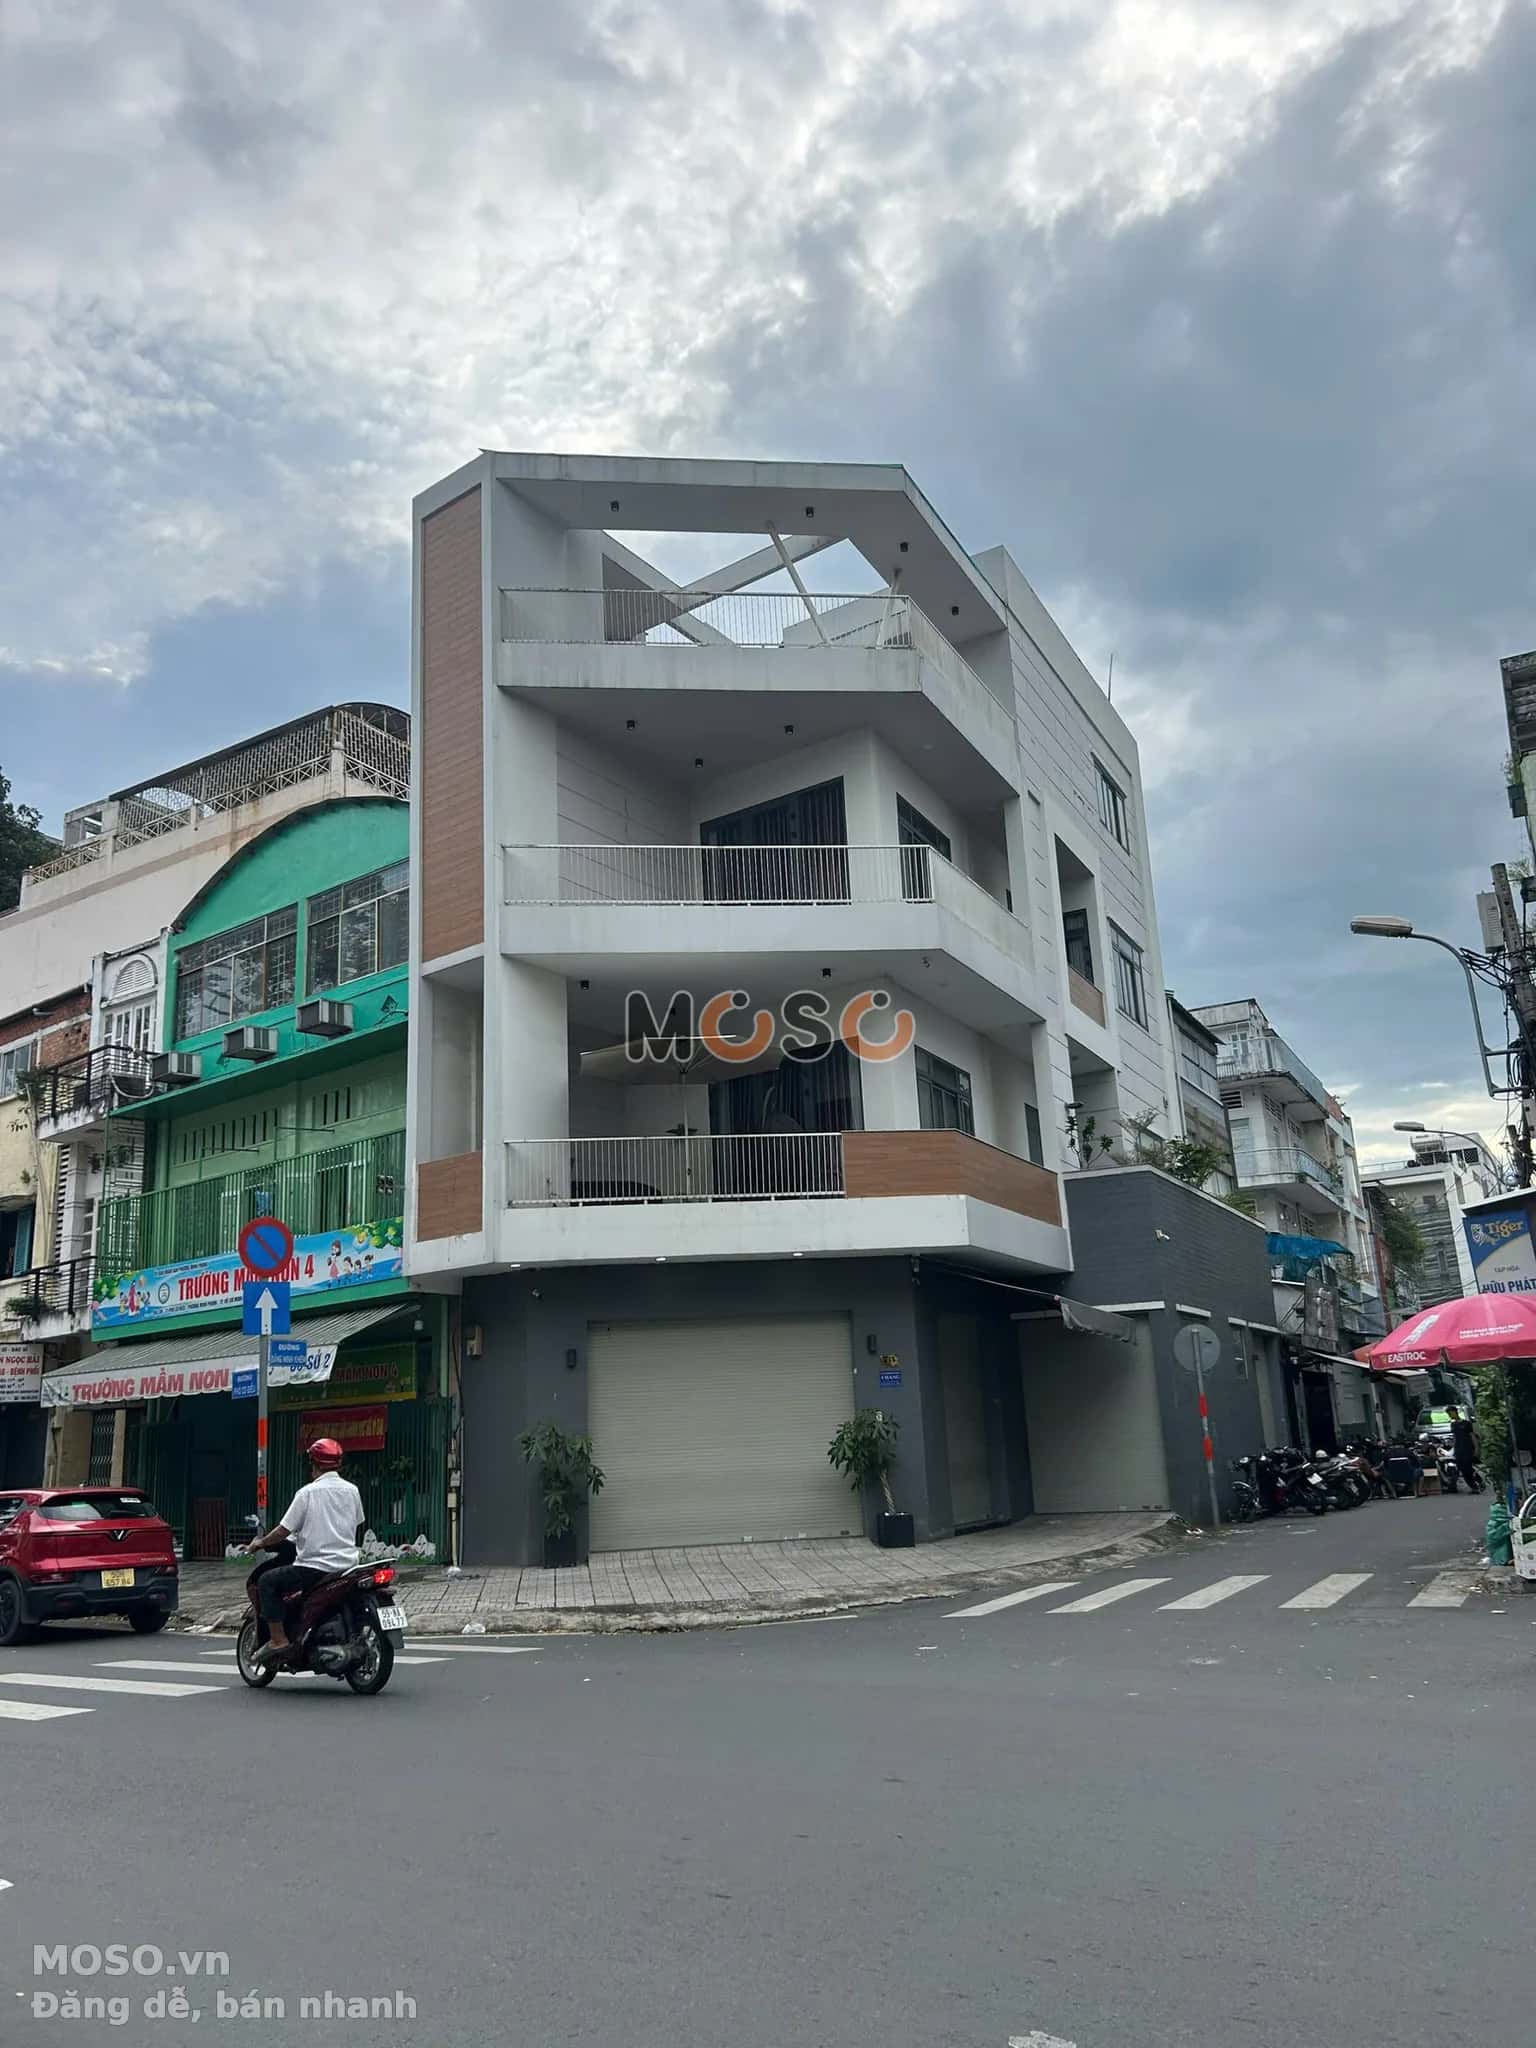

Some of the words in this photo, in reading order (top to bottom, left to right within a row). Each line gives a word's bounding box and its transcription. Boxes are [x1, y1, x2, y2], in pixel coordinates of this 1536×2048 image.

[1485, 1220, 1523, 1237] Tiger
[177, 1270, 229, 1300] TRƯỜNG
[304, 1254, 314, 1278] 4
[324, 1353, 331, 1368] 2
[1388, 1352, 1427, 1364] EASTROC
[72, 1377, 135, 1400] TRƯỜNG
[140, 1367, 184, 1395] MẦM
[189, 1369, 229, 1391] NON
